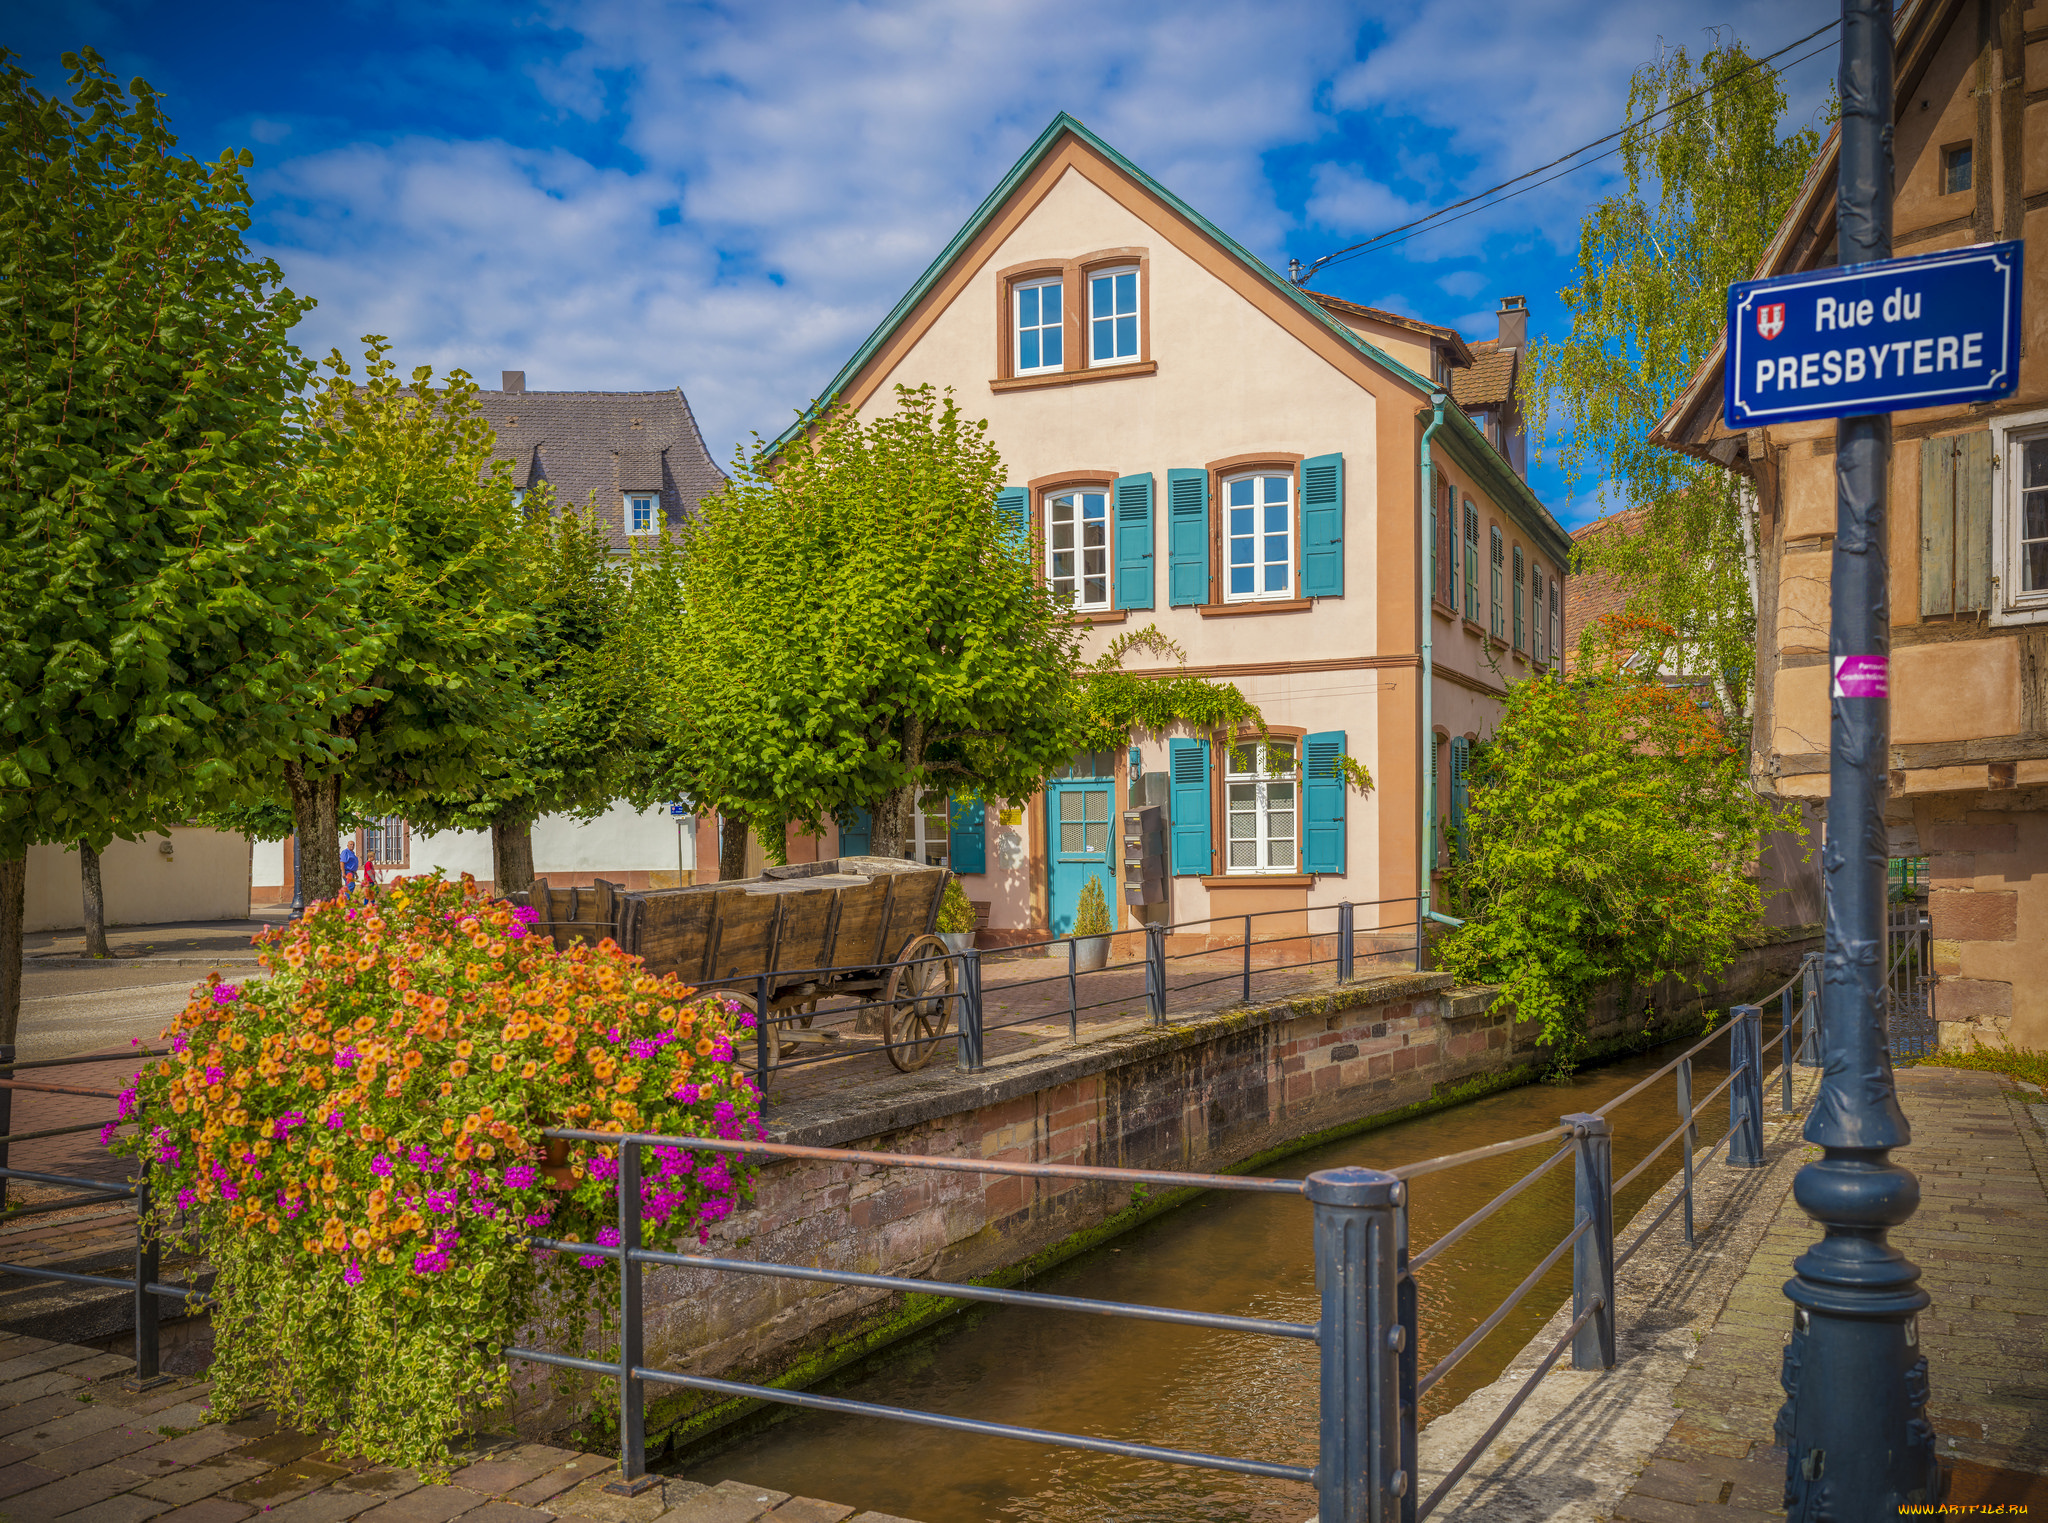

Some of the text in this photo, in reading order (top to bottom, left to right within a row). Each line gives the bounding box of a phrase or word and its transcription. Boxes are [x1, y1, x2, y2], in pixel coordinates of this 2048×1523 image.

[1816, 287, 1922, 332] Rue du
[1756, 332, 1984, 394] PRESBYTERE
